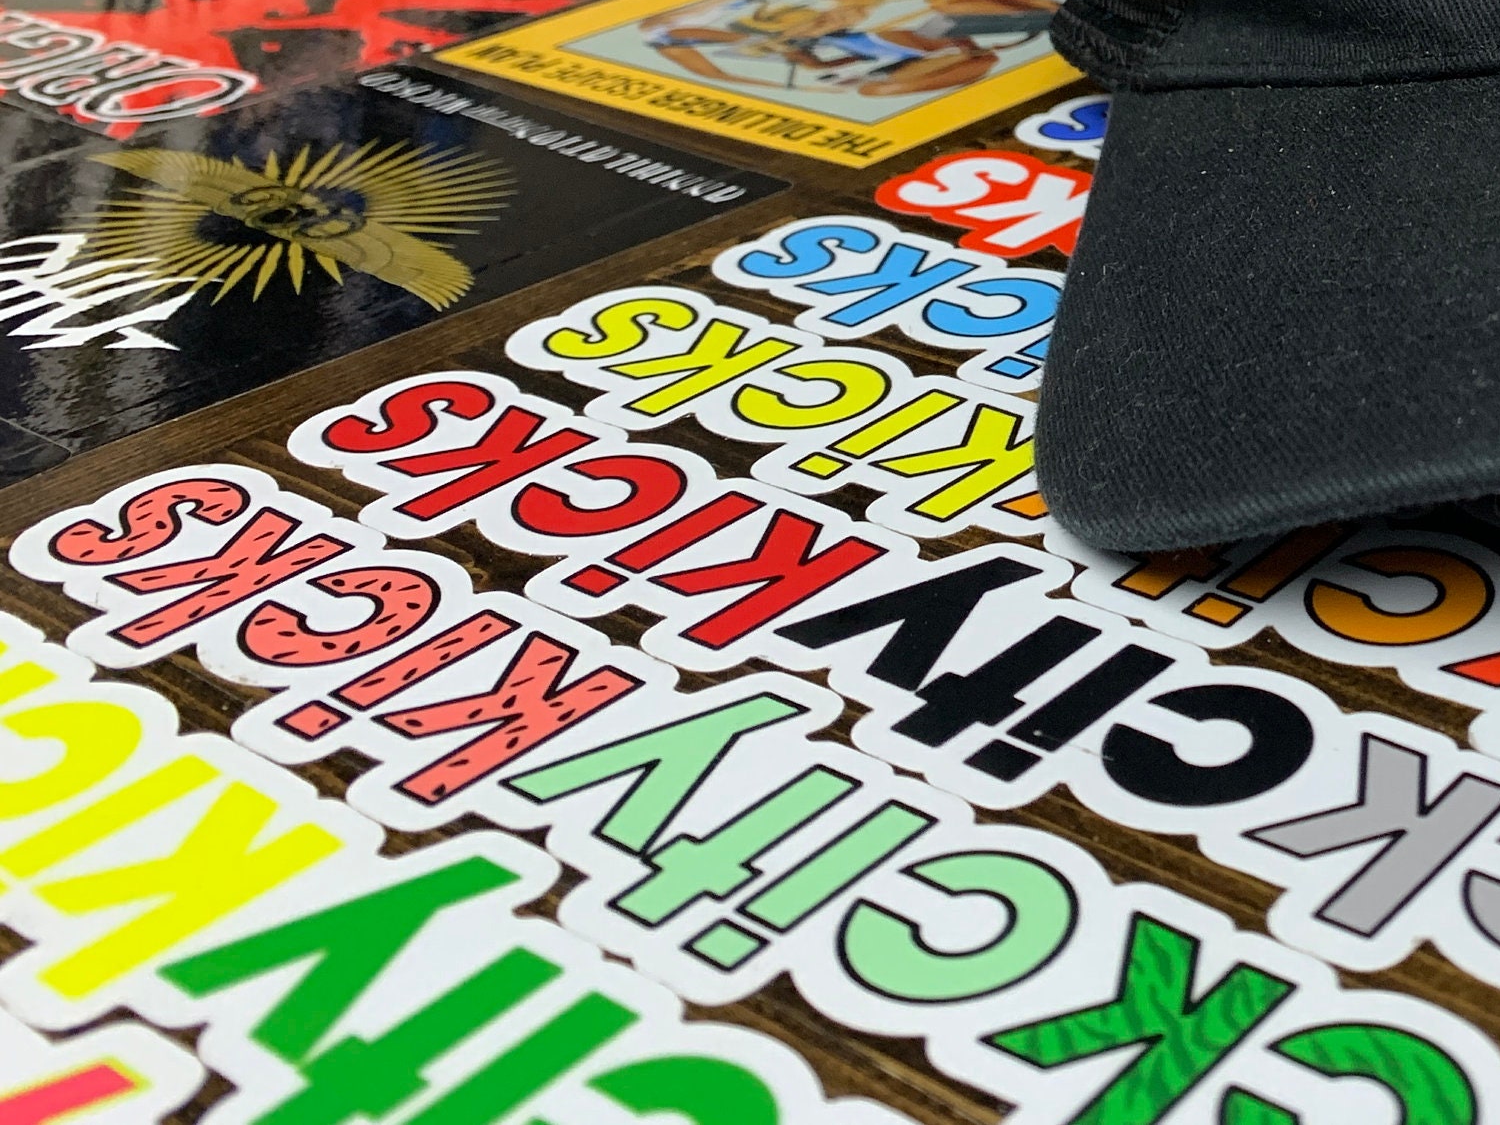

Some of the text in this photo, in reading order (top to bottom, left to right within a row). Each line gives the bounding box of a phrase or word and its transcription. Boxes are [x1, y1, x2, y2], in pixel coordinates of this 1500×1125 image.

[470, 43, 894, 159] THE DILLINGER ESCAPE PLAN
[320, 380, 890, 650] kicks
[541, 297, 1037, 523] kicks
[47, 477, 647, 806] kicks
[773, 555, 1315, 807] city
[498, 690, 1079, 1003] city
